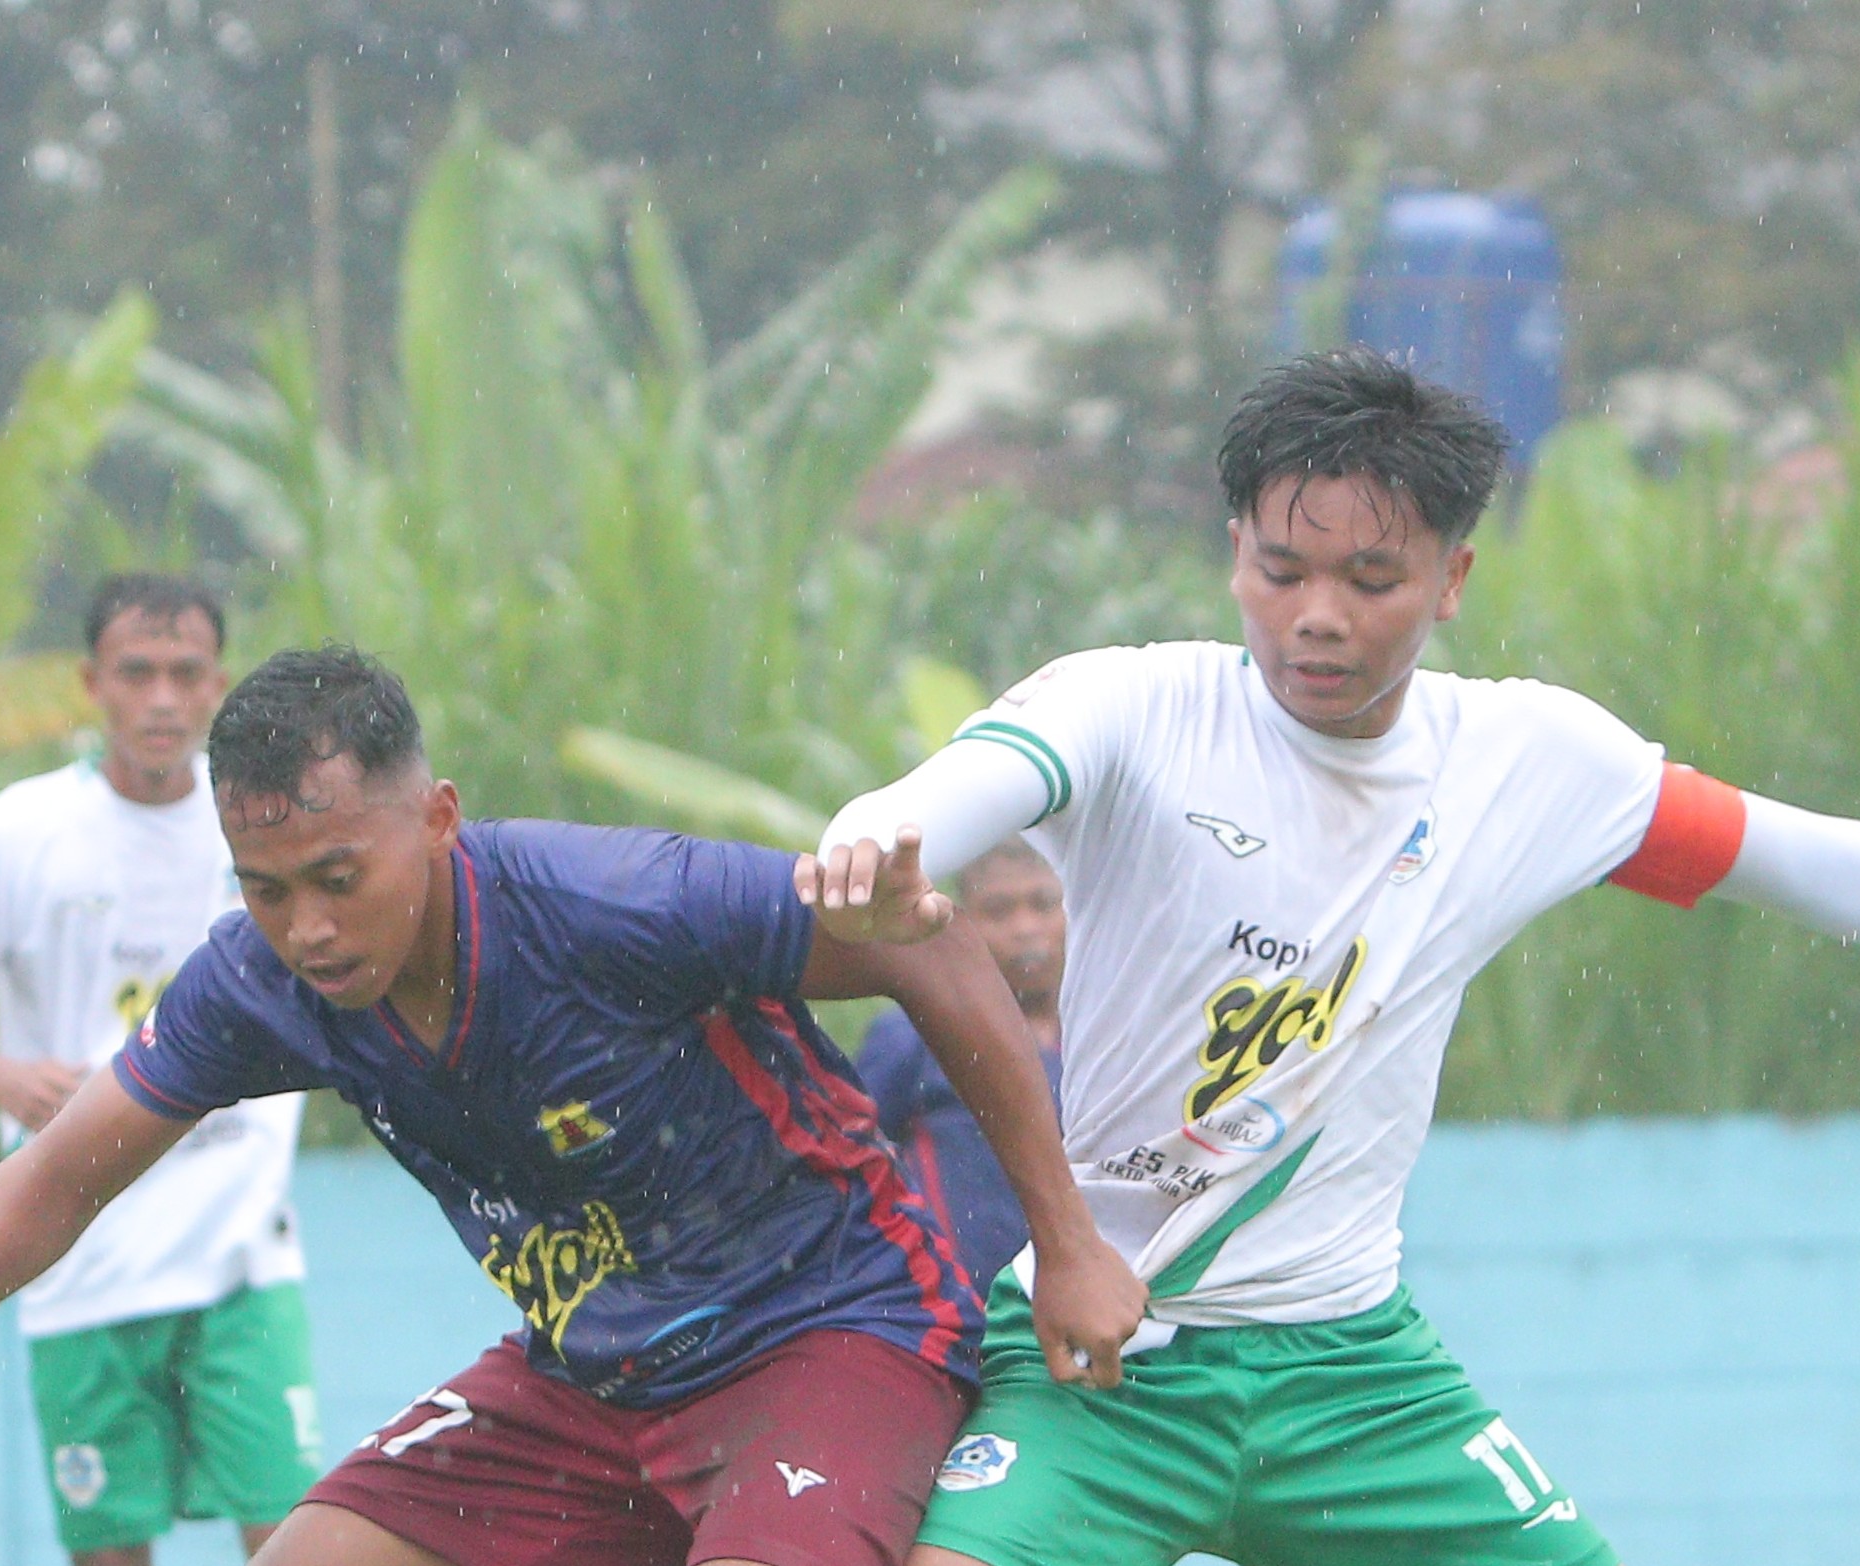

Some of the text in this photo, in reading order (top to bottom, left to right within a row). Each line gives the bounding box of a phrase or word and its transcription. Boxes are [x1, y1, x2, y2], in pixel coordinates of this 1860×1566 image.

[1228, 920, 1313, 971] Kopi
[1218, 1120, 1262, 1145] HIJAZ
[1461, 1416, 1553, 1513] 17
